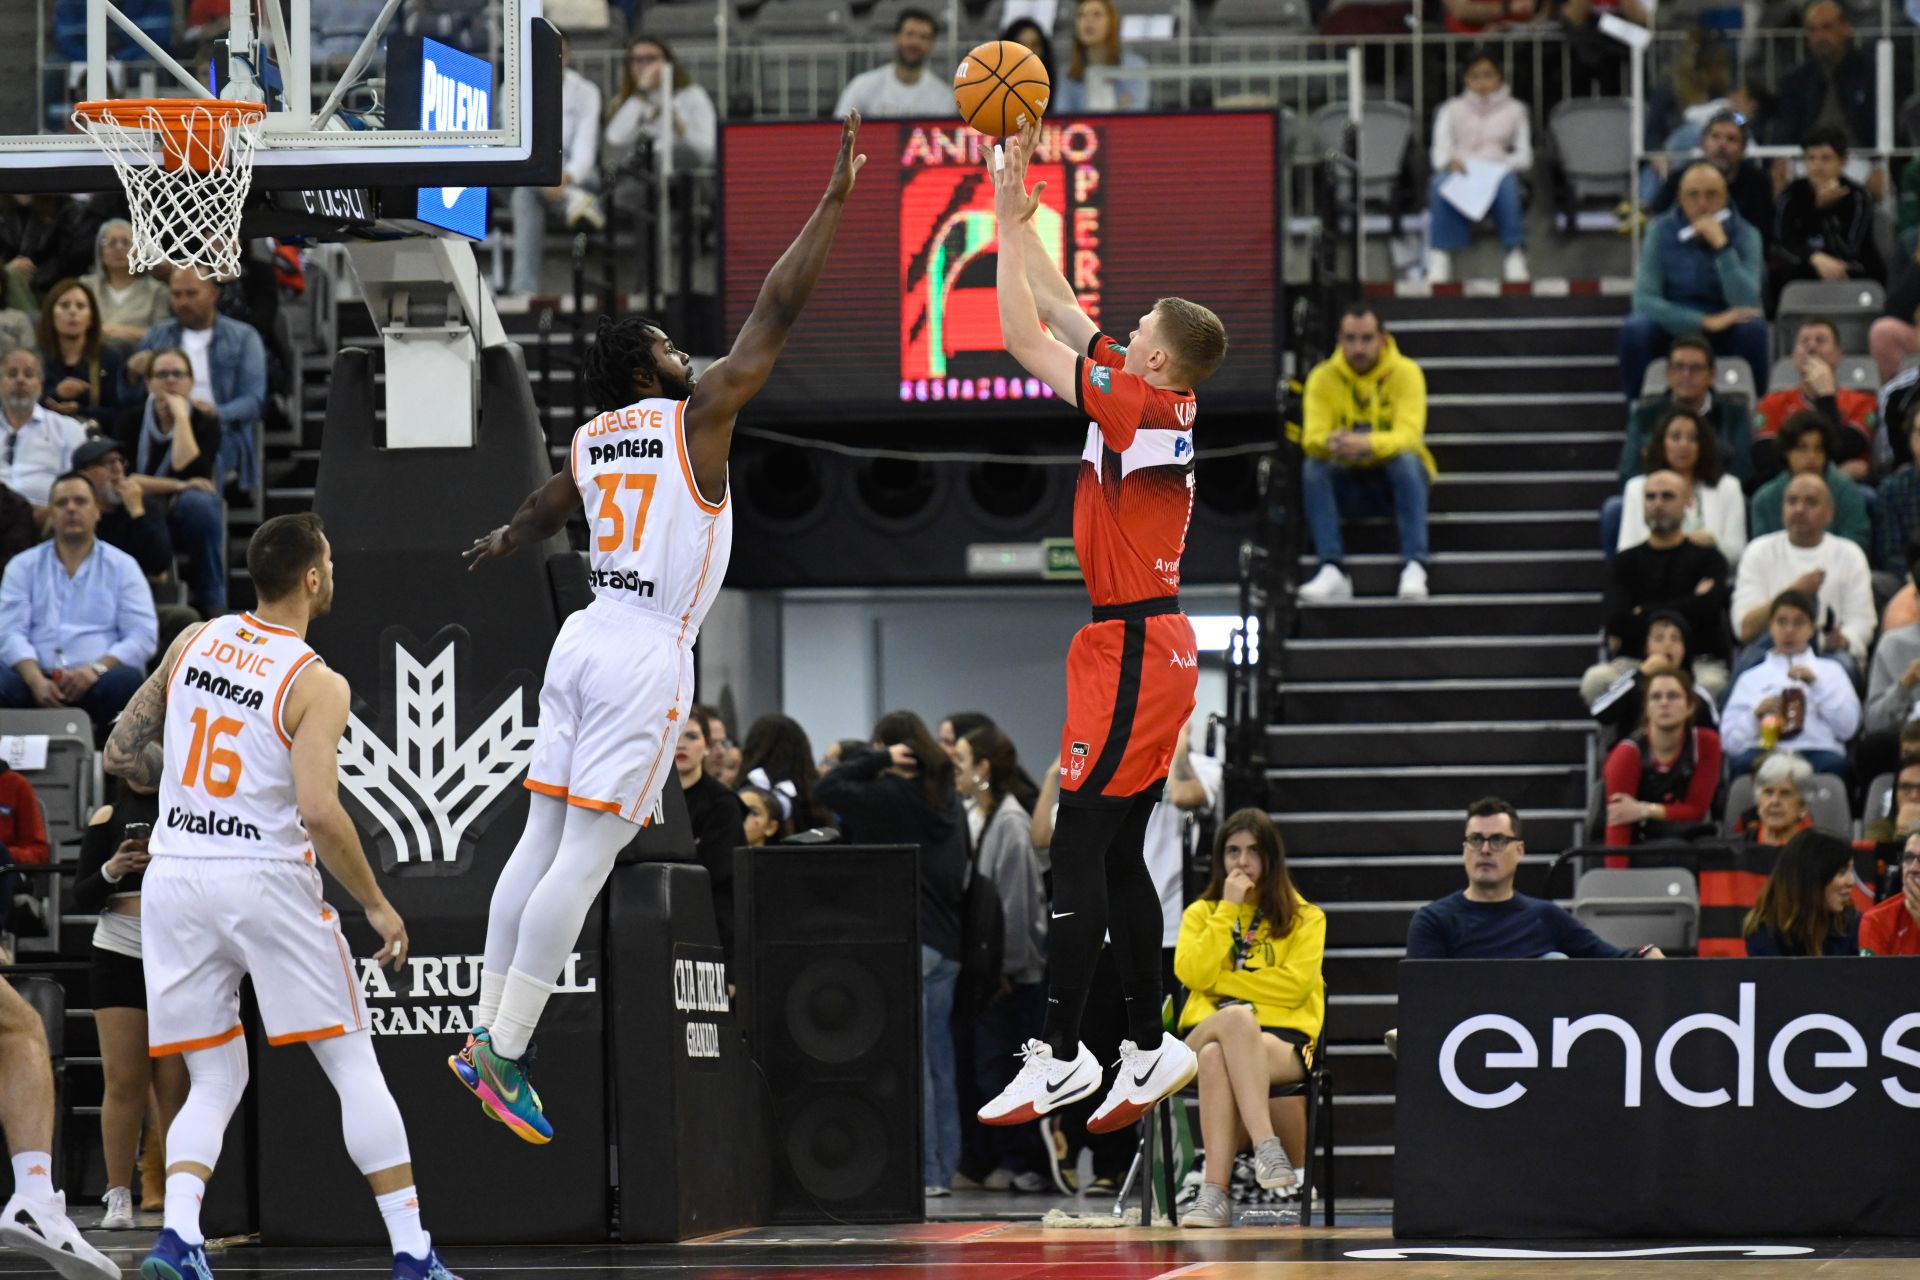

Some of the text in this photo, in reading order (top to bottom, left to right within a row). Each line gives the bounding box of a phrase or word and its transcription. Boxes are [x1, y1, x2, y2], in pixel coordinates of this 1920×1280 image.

[587, 409, 664, 437] OJELEYE
[588, 438, 664, 465] PAMESA
[593, 473, 658, 552] 37
[201, 638, 275, 678] JOVIC
[184, 666, 264, 710] PAMESA
[181, 707, 245, 799] 16
[674, 959, 730, 1013] CAJA RURAL
[686, 1022, 721, 1058] GRANADA
